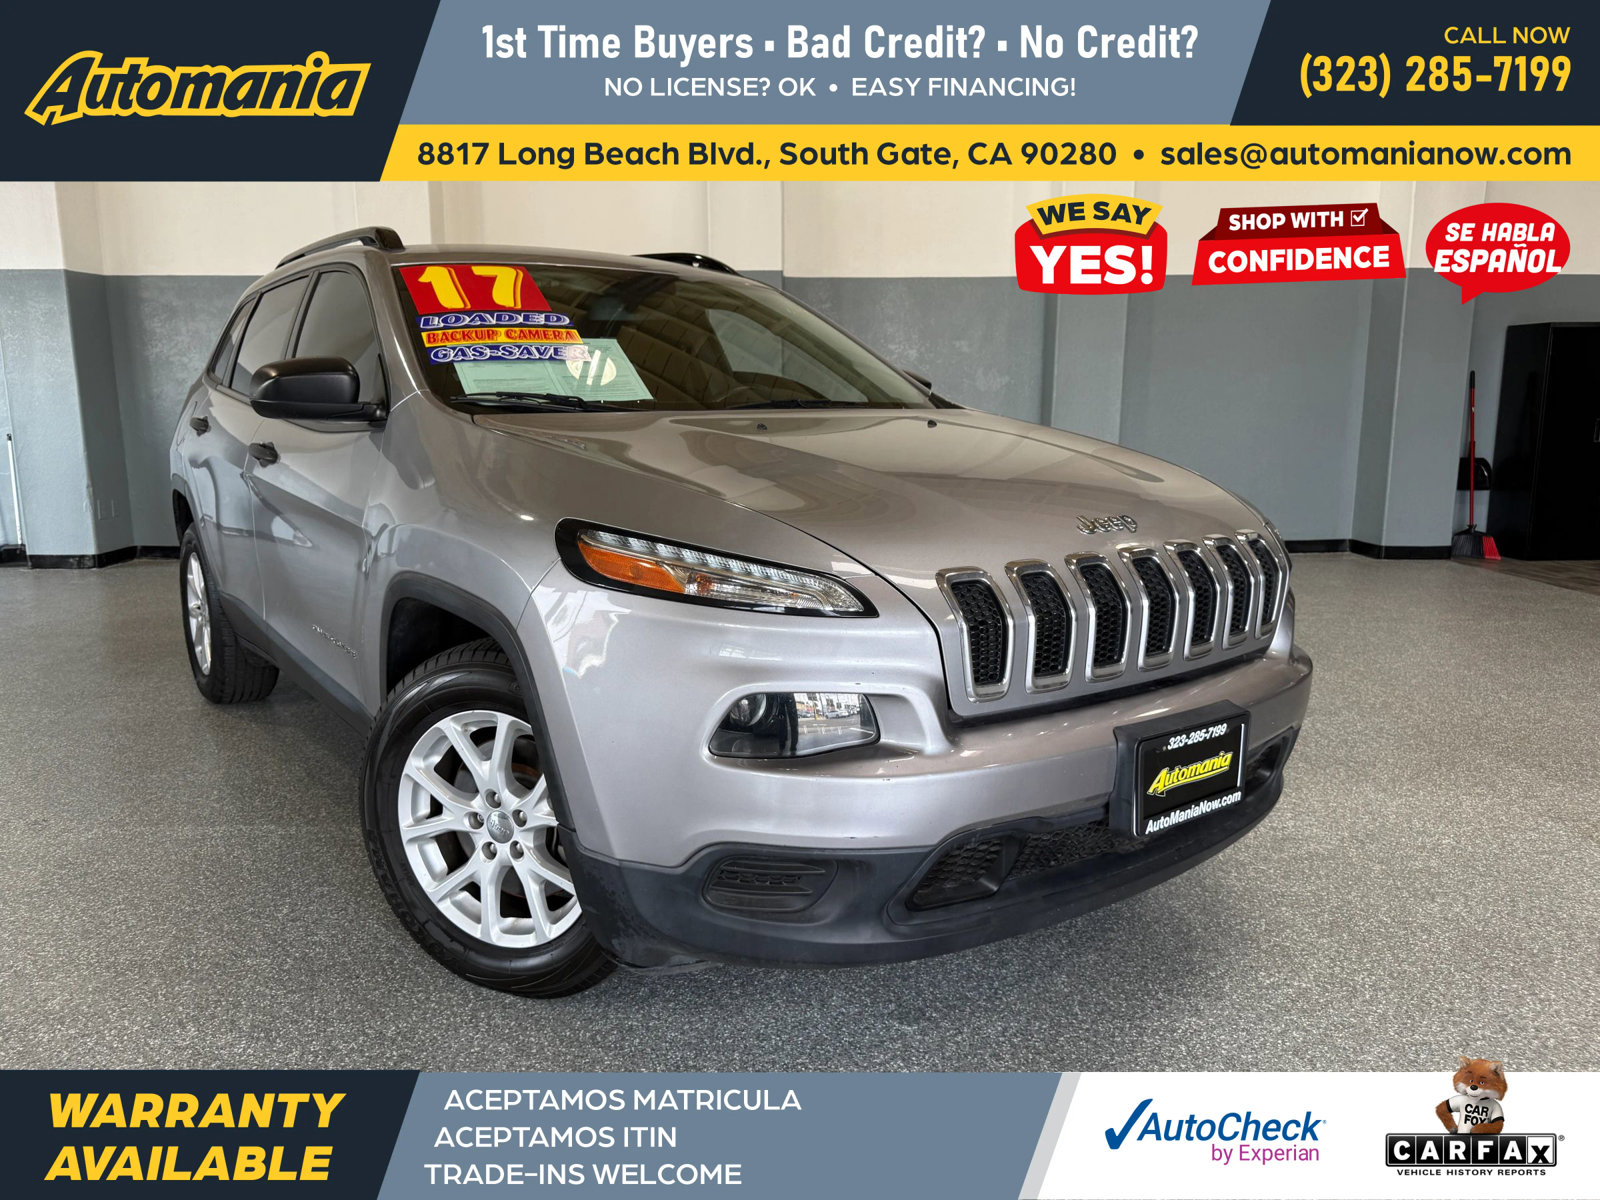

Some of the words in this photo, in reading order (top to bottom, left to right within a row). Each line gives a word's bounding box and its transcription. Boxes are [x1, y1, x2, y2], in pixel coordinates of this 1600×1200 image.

[418, 266, 524, 309] 17
[420, 312, 571, 329] LOADED
[426, 330, 502, 345] BACKUP
[504, 329, 577, 342] CAMERA
[1076, 515, 1138, 534] Jeep
[1167, 723, 1228, 751] 323-285-7199
[1147, 751, 1234, 797] Automania
[1145, 791, 1242, 835] AutoManiaNow.com
